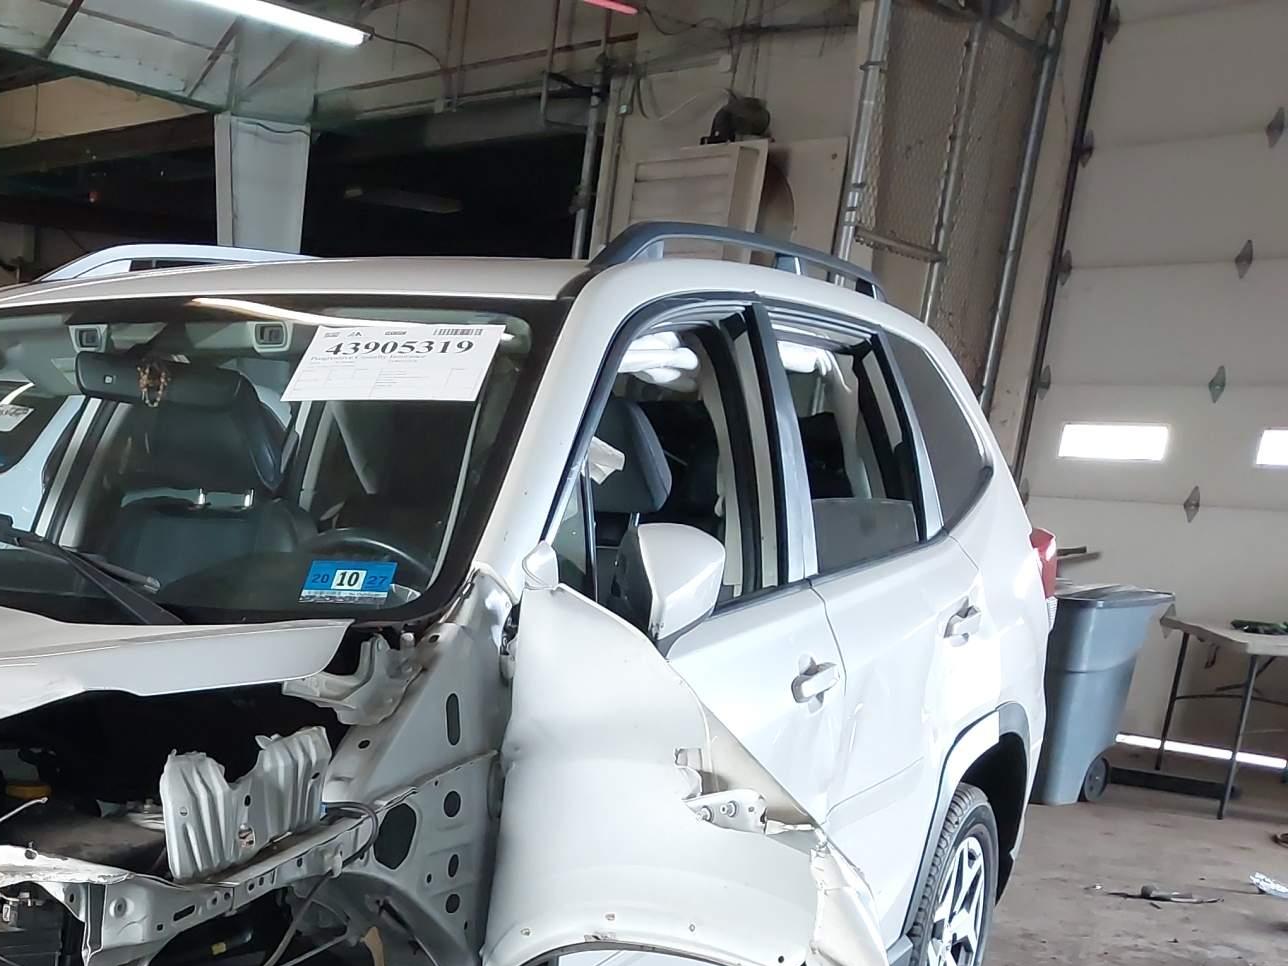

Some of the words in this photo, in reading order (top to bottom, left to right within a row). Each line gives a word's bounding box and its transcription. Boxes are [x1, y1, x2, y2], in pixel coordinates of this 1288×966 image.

[325, 339, 475, 356] 43905319
[311, 573, 330, 584] 20
[335, 571, 360, 587] 10
[366, 575, 388, 585] 27
